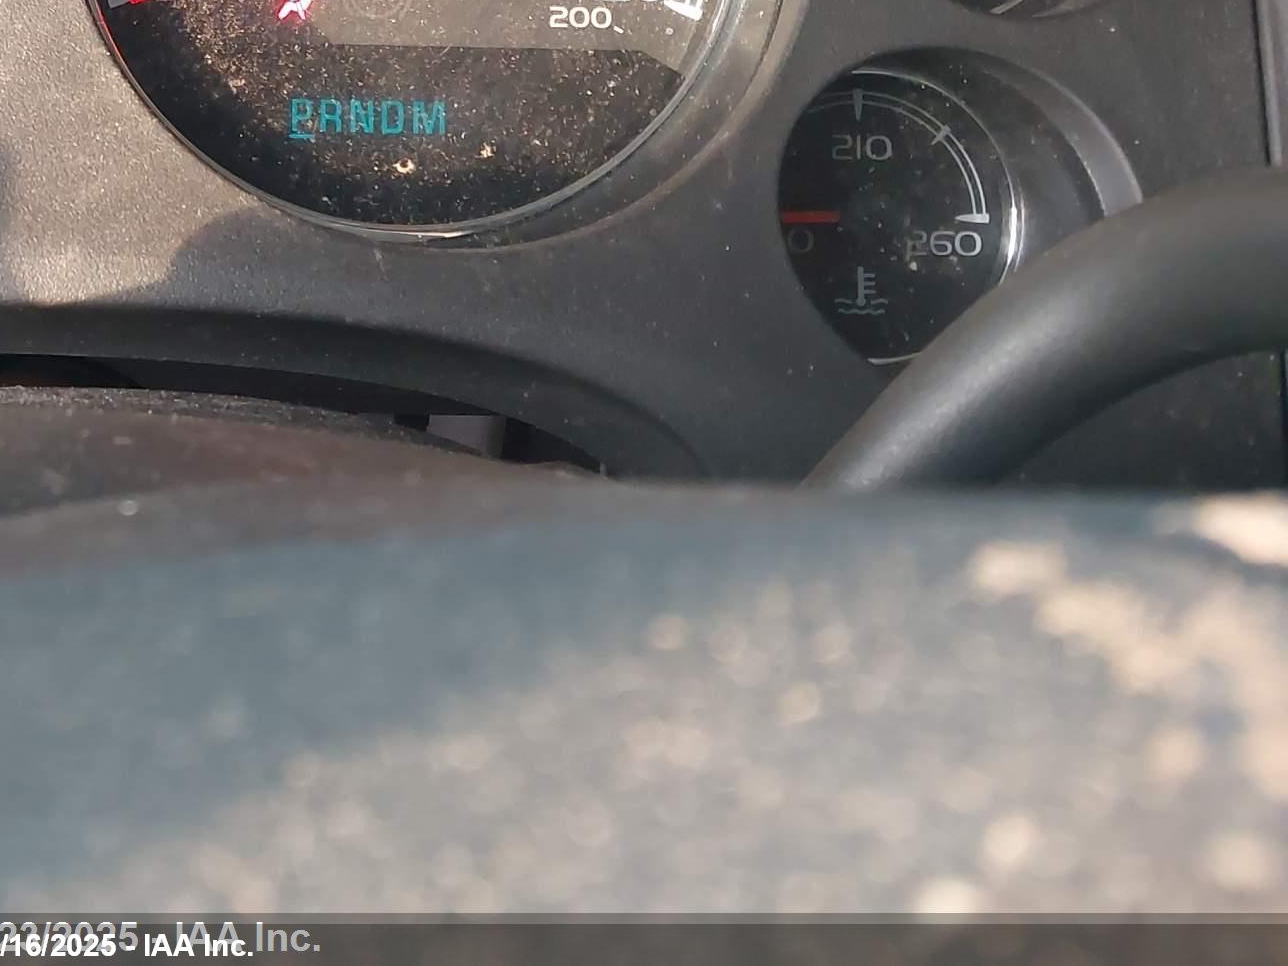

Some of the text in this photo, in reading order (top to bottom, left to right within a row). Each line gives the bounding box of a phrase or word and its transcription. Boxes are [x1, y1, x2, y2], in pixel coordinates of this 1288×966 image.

[549, 7, 612, 28] 200
[289, 98, 447, 135] PRNDM
[832, 135, 893, 160] 210
[907, 231, 983, 256] 260
